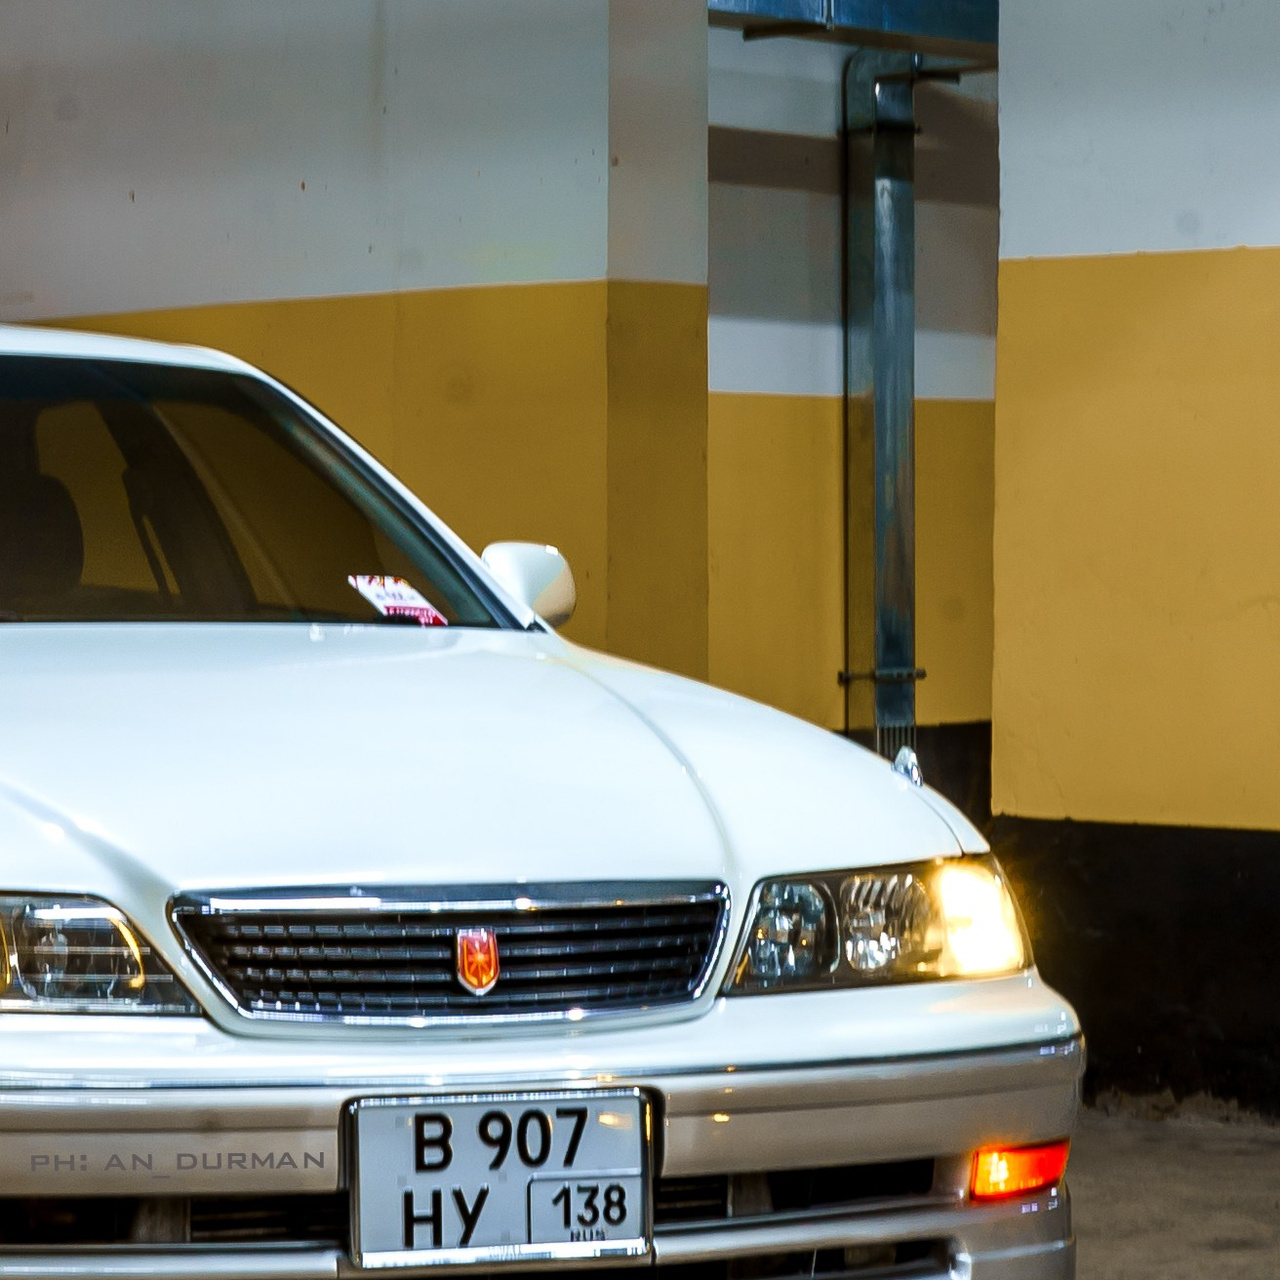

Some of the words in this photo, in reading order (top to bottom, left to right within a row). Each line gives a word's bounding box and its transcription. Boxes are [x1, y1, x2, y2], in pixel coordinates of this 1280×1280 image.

[414, 1112, 454, 1173] В
[477, 1106, 588, 1171] 907
[552, 1183, 627, 1228] 138
